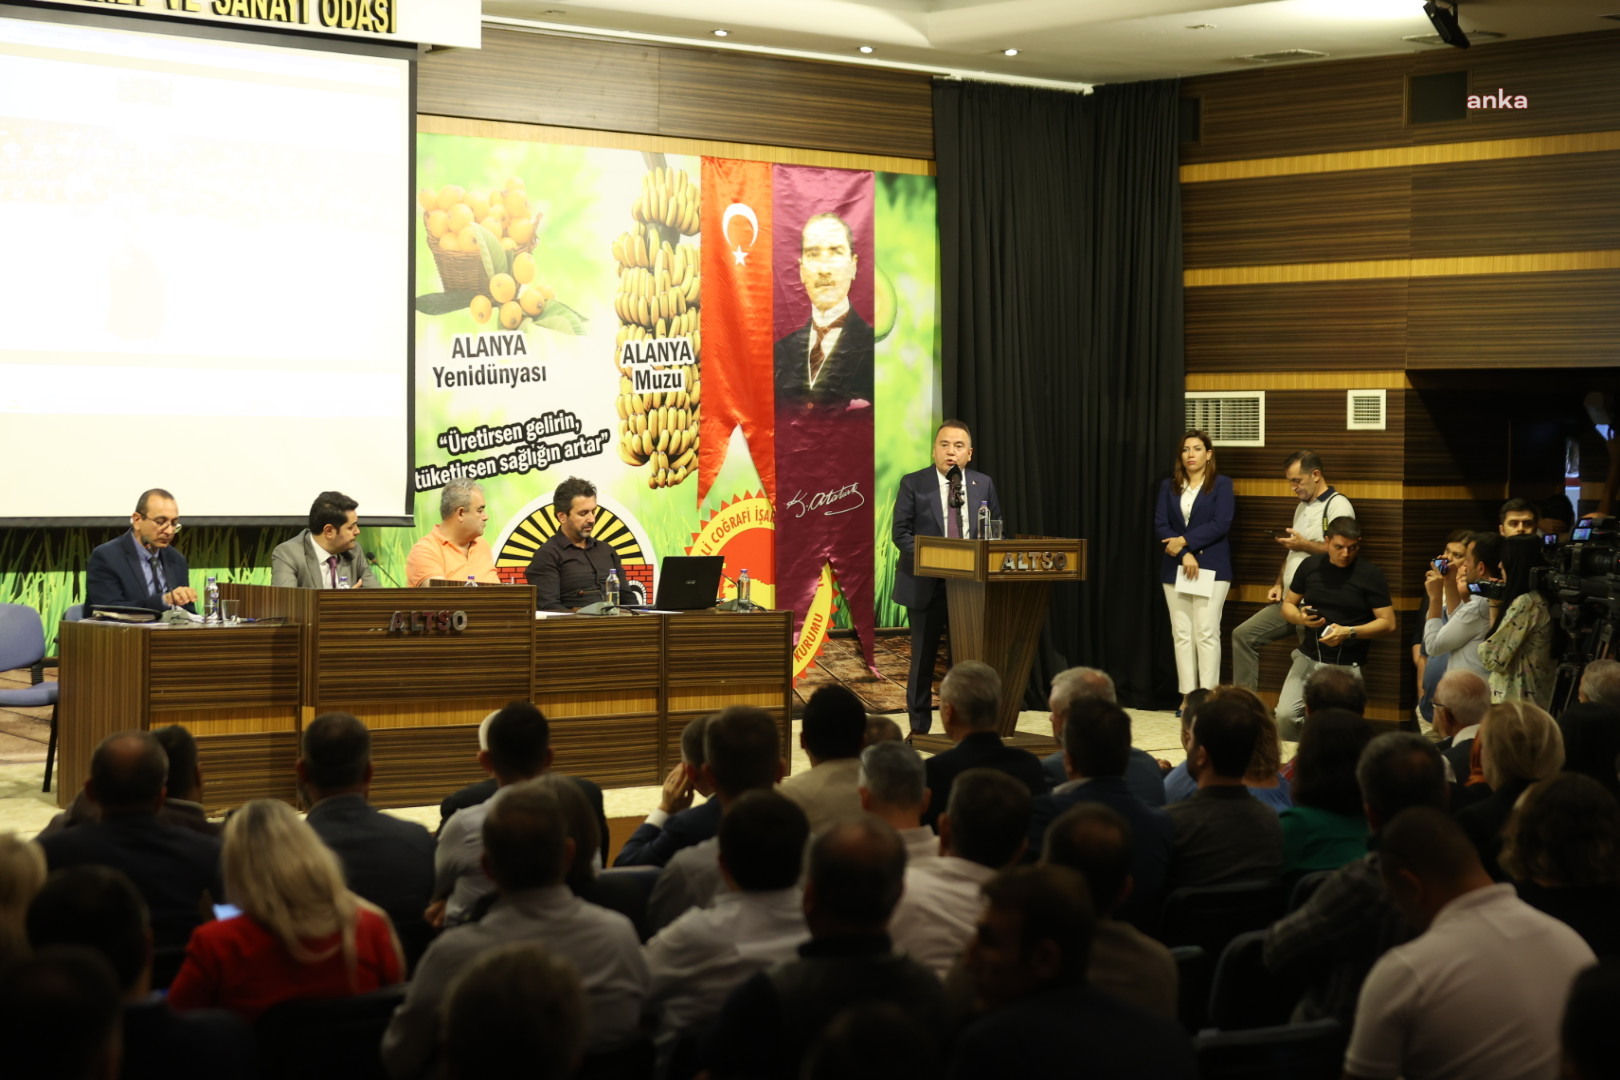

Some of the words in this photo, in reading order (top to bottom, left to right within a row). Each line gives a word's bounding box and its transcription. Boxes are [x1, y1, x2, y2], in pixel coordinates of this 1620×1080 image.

[319, 0, 397, 34] ODASI
[451, 334, 527, 359] ALANYA
[622, 340, 692, 364] ALANYA
[432, 364, 547, 388] Yenidünyası
[634, 370, 682, 390] Muzu
[526, 412, 580, 441] gelirin,
[414, 459, 497, 489] tüketirsen
[564, 431, 609, 458] artar”
[710, 507, 751, 543] COĞRAFİ
[1001, 551, 1067, 571] ALTSO
[389, 610, 468, 632] ALTSO
[793, 612, 824, 663] KURUMU
